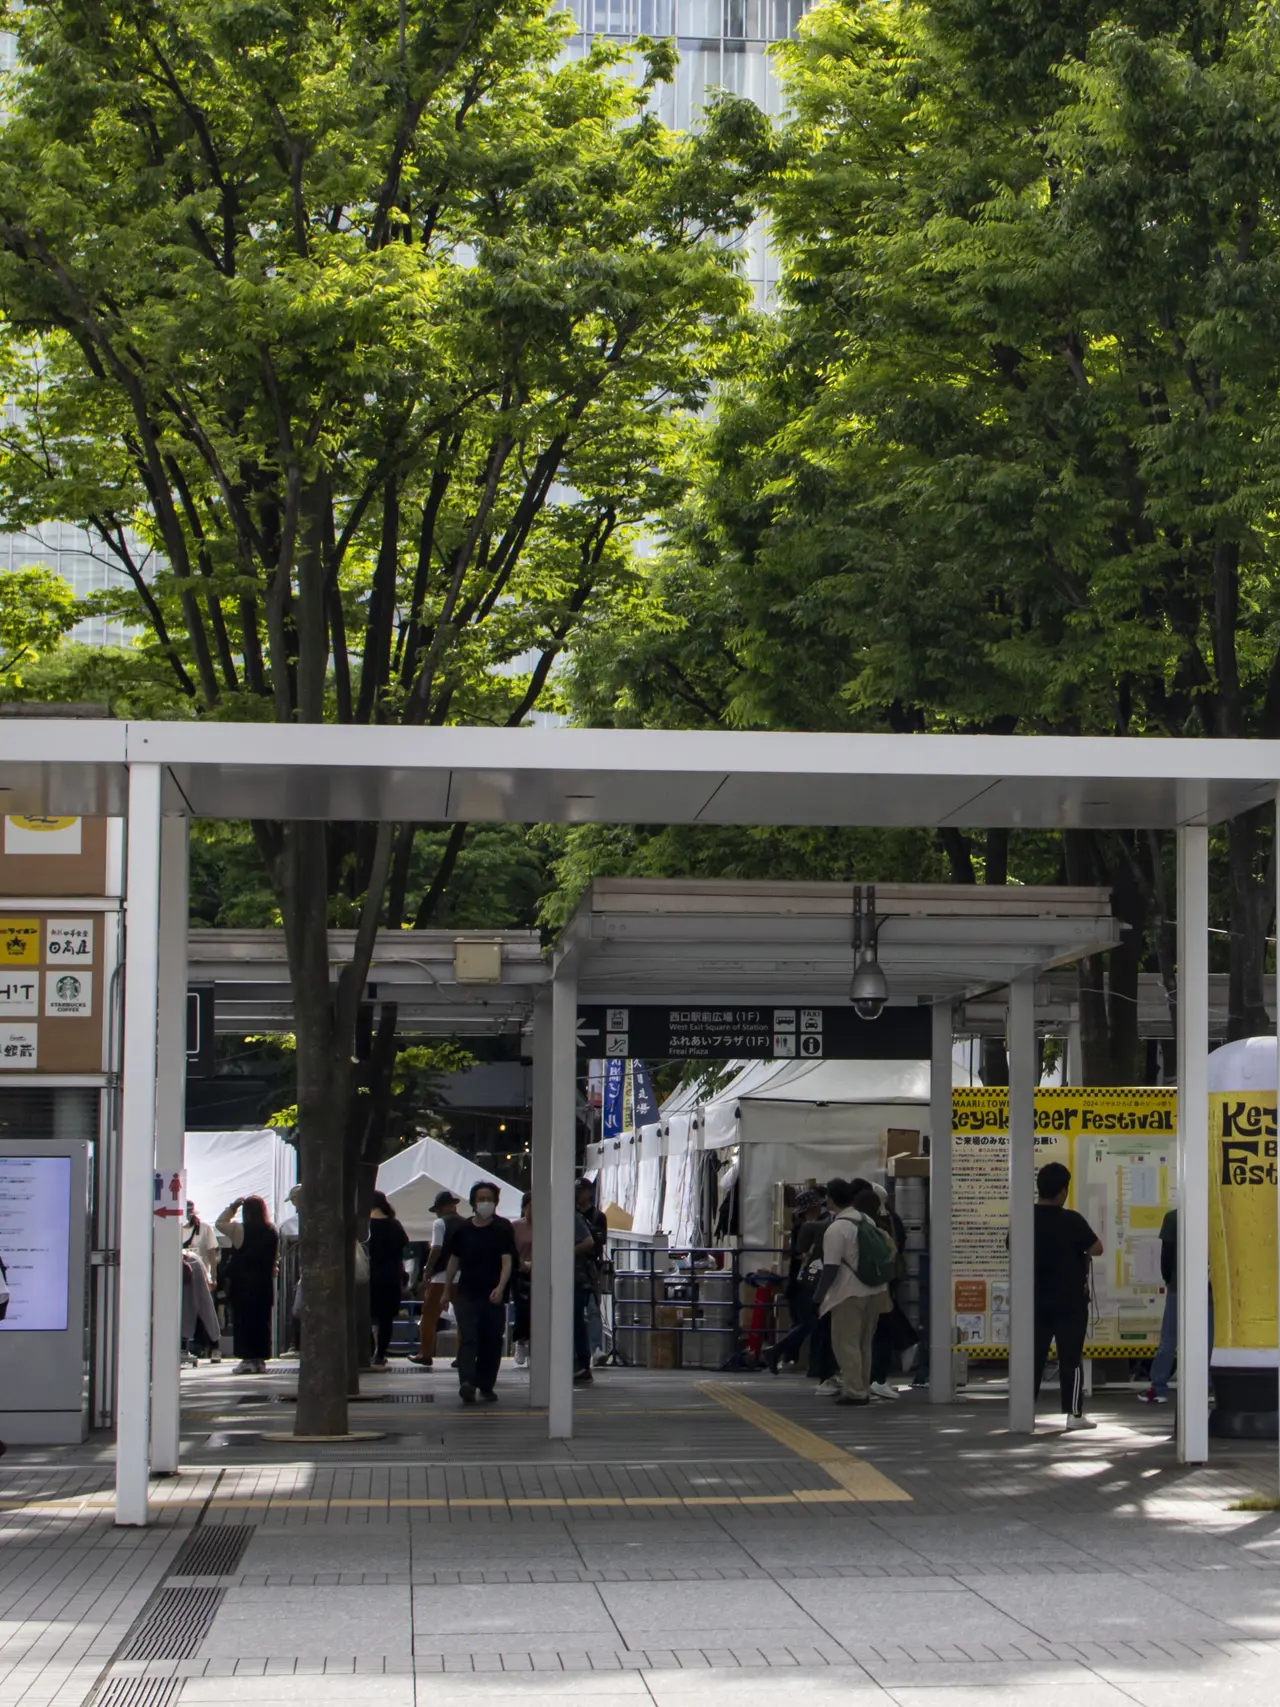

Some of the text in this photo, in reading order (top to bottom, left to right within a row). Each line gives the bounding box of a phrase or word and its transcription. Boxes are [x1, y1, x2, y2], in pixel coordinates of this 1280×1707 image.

[669, 1023, 769, 1032] West Exit Square of Station
[669, 1035, 770, 1047] ふれあいプラザ(1F)
[1081, 1109, 1173, 1130] Festival
